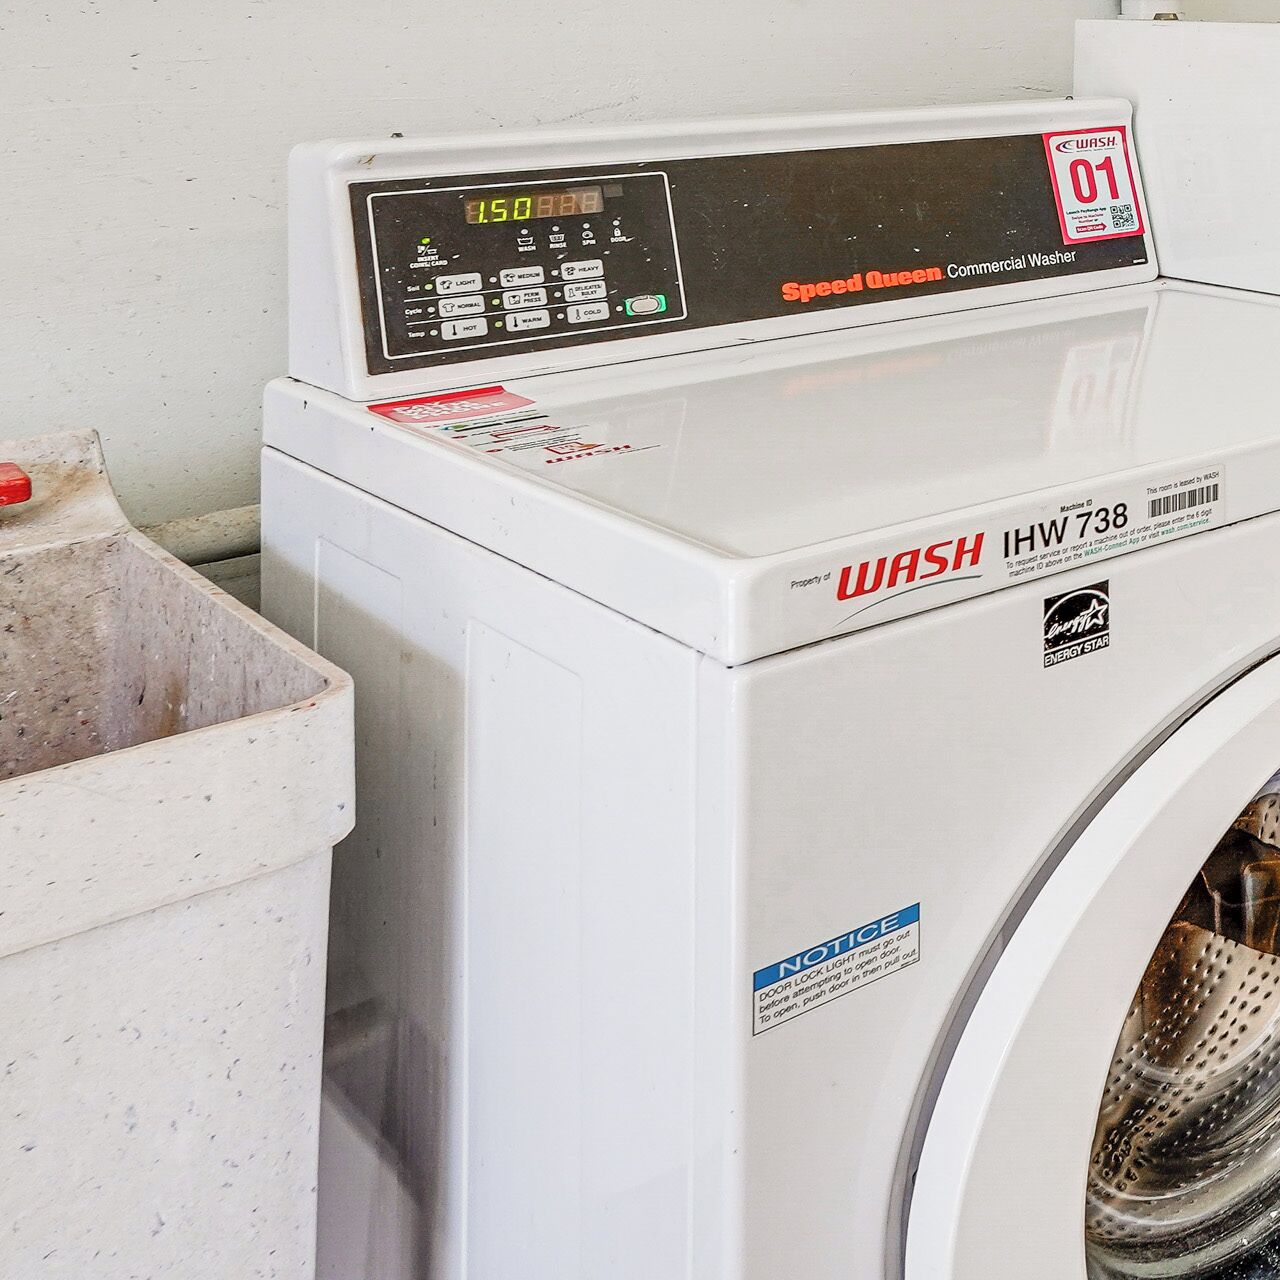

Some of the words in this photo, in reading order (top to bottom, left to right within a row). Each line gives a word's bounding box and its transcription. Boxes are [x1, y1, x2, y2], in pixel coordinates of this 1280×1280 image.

[1069, 156, 1120, 204] 01
[455, 278, 477, 287] LIGHT
[782, 274, 864, 303] Speed
[865, 265, 943, 290] Queen
[946, 254, 1027, 279] Commercial
[1028, 249, 1078, 267] Washer
[584, 308, 602, 316] COLD
[837, 532, 986, 602] WASH
[1003, 516, 1070, 559] IHW
[1075, 502, 1129, 539] 738
[1044, 642, 1082, 666] ENERGY
[1083, 634, 1110, 653] STAR
[759, 981, 792, 1003] DOOR
[794, 967, 824, 986] LOCK
[826, 953, 856, 973] LIGHT
[858, 942, 882, 959] must
[883, 937, 895, 950] go
[896, 929, 911, 942] out
[778, 912, 900, 979] NOTICE
[759, 994, 790, 1013] before
[792, 971, 842, 999] attempting
[843, 965, 853, 974] to
[854, 956, 878, 970] open
